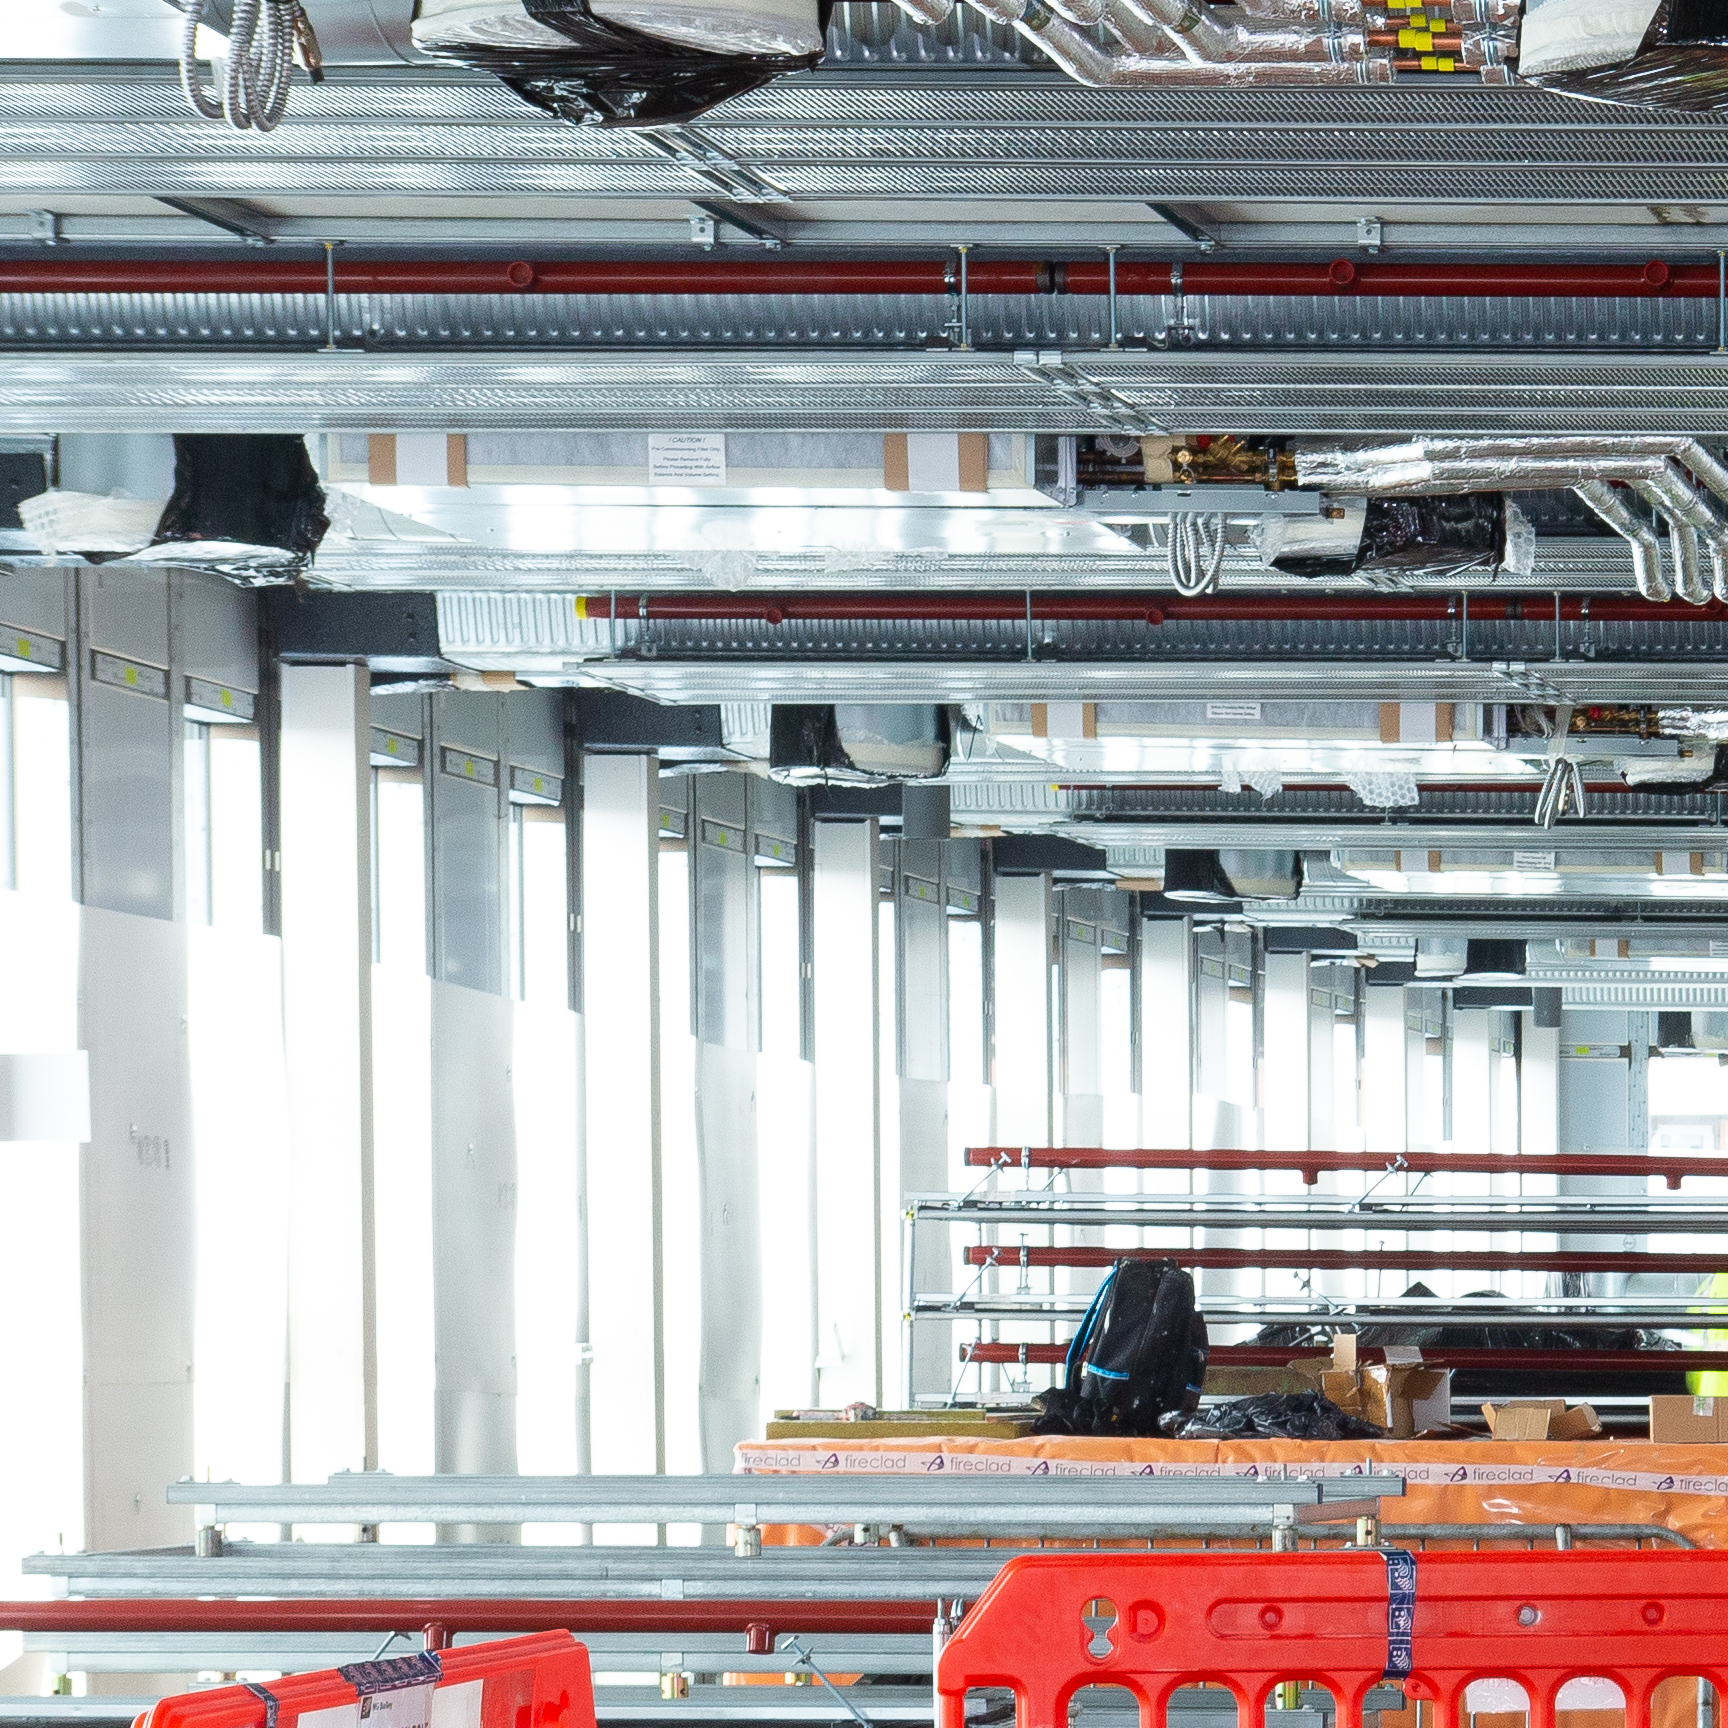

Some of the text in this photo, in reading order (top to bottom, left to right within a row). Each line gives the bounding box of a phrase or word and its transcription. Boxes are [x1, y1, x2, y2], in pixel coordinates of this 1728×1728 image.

[845, 1454, 906, 1468] fireclad
[950, 1456, 1012, 1472] fireclad
[1054, 1462, 1116, 1476] fireclad
[1473, 1468, 1534, 1482] fireclad
[1577, 1472, 1638, 1486] fireclad
